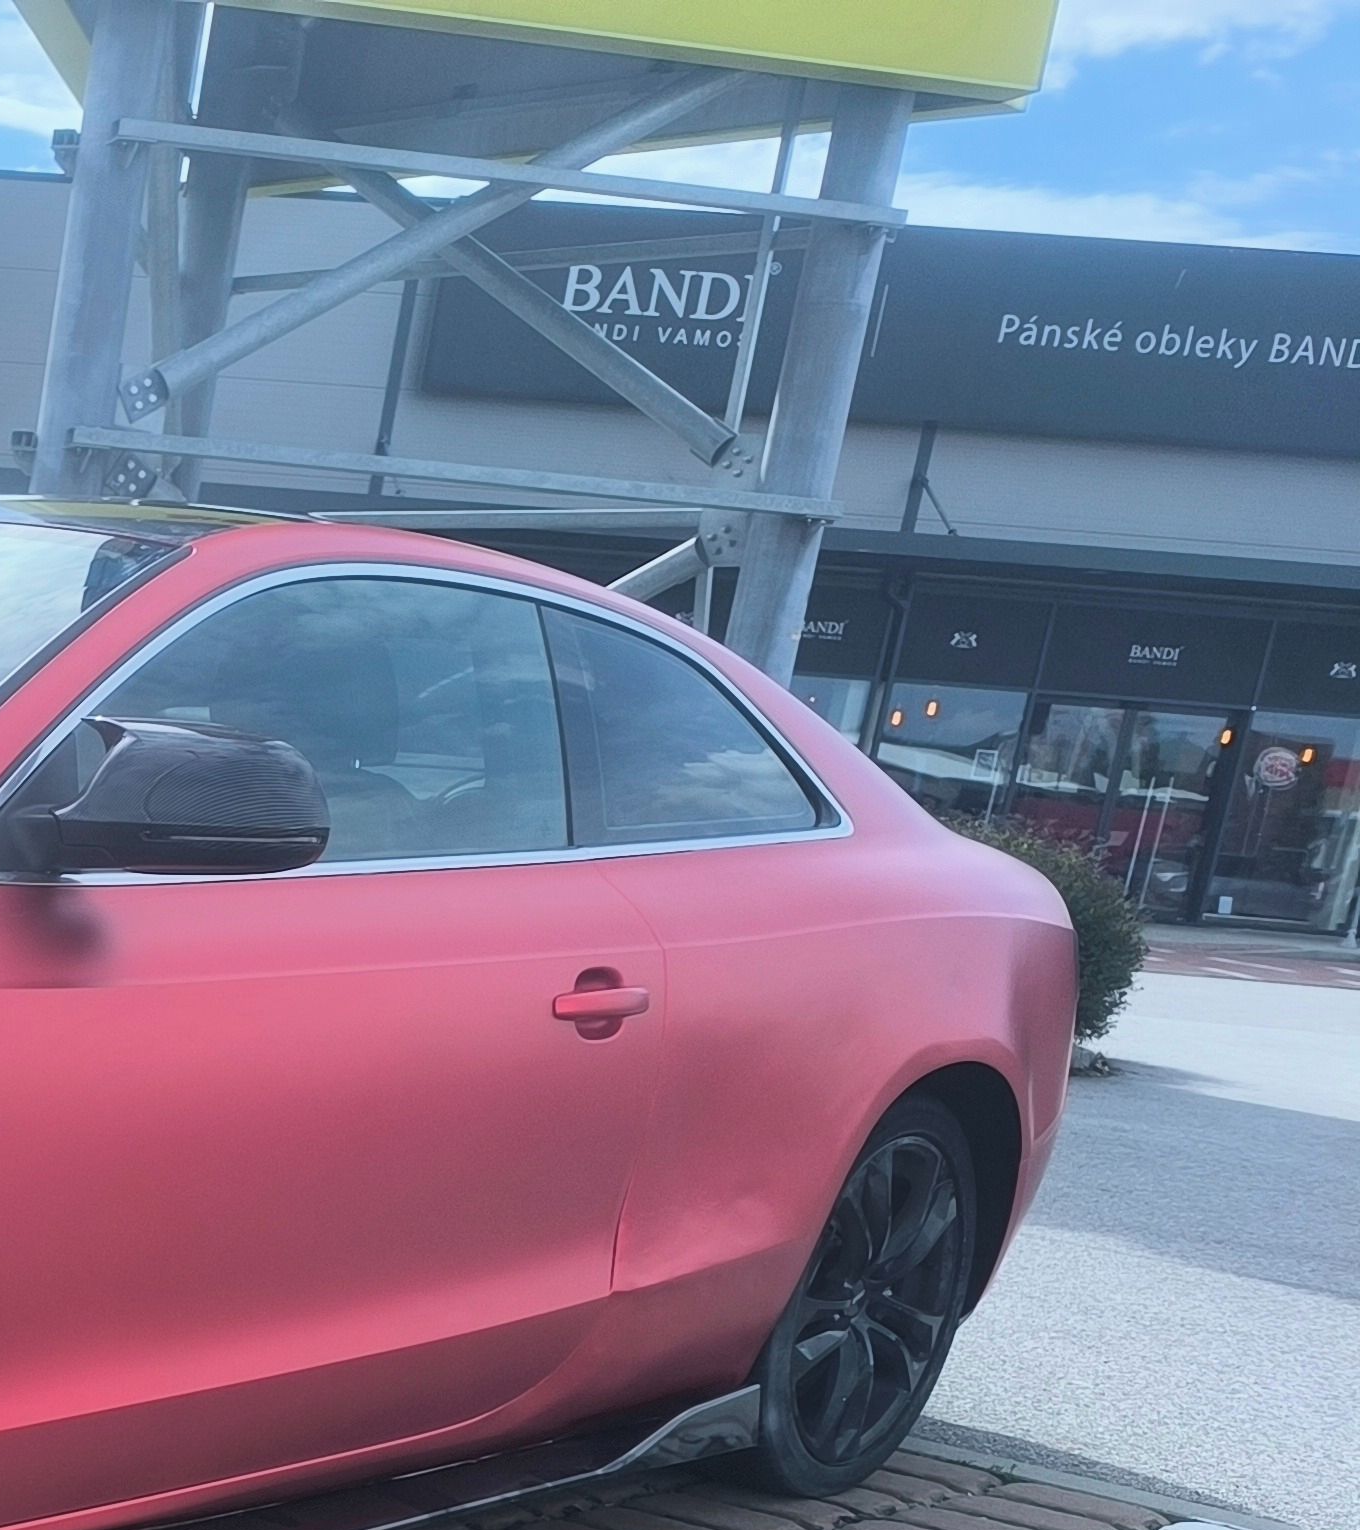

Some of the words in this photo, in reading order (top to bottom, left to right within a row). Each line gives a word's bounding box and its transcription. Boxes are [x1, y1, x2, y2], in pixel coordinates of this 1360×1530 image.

[996, 313, 1124, 352] Pánské
[1135, 323, 1259, 369] obleky
[1129, 644, 1179, 661] BANDI
